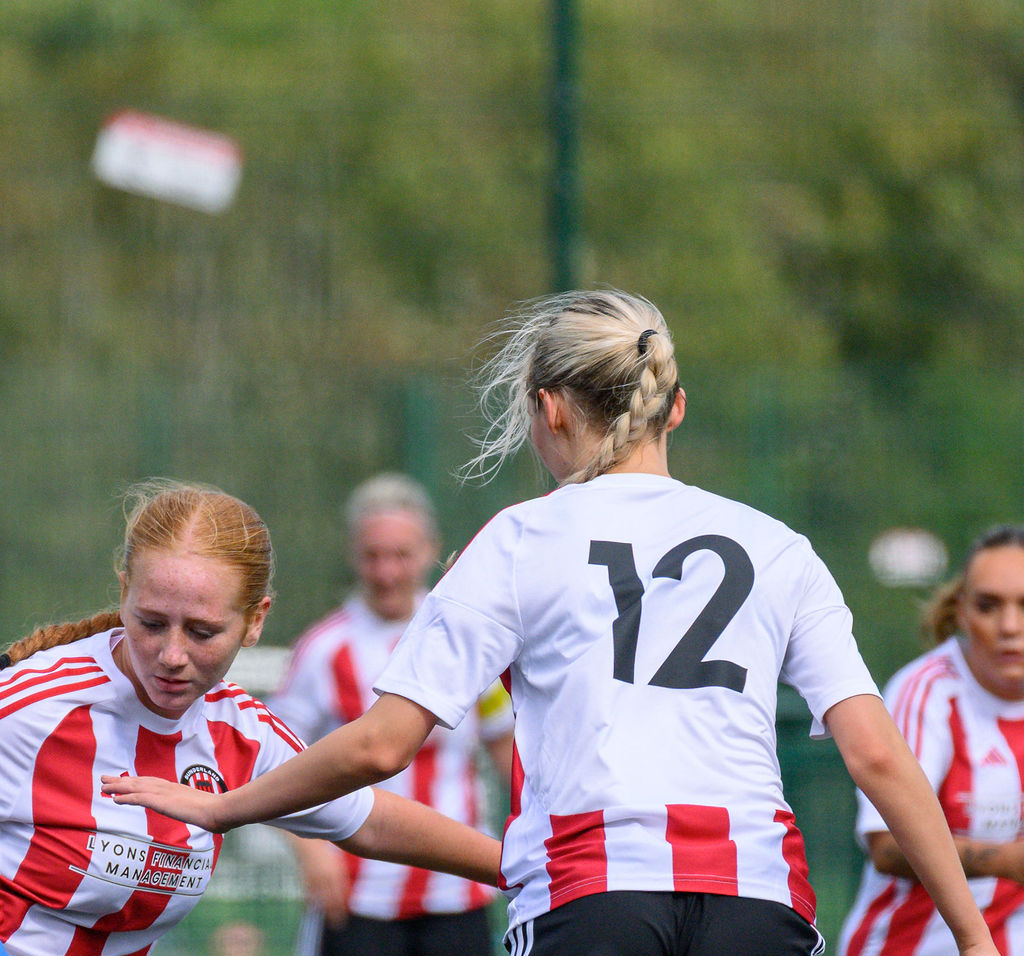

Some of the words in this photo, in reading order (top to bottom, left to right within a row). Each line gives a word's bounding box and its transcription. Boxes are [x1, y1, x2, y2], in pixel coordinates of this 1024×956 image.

[588, 534, 755, 693] 12
[87, 835, 146, 862] LYONS
[105, 861, 203, 889] MANAGEMENT
